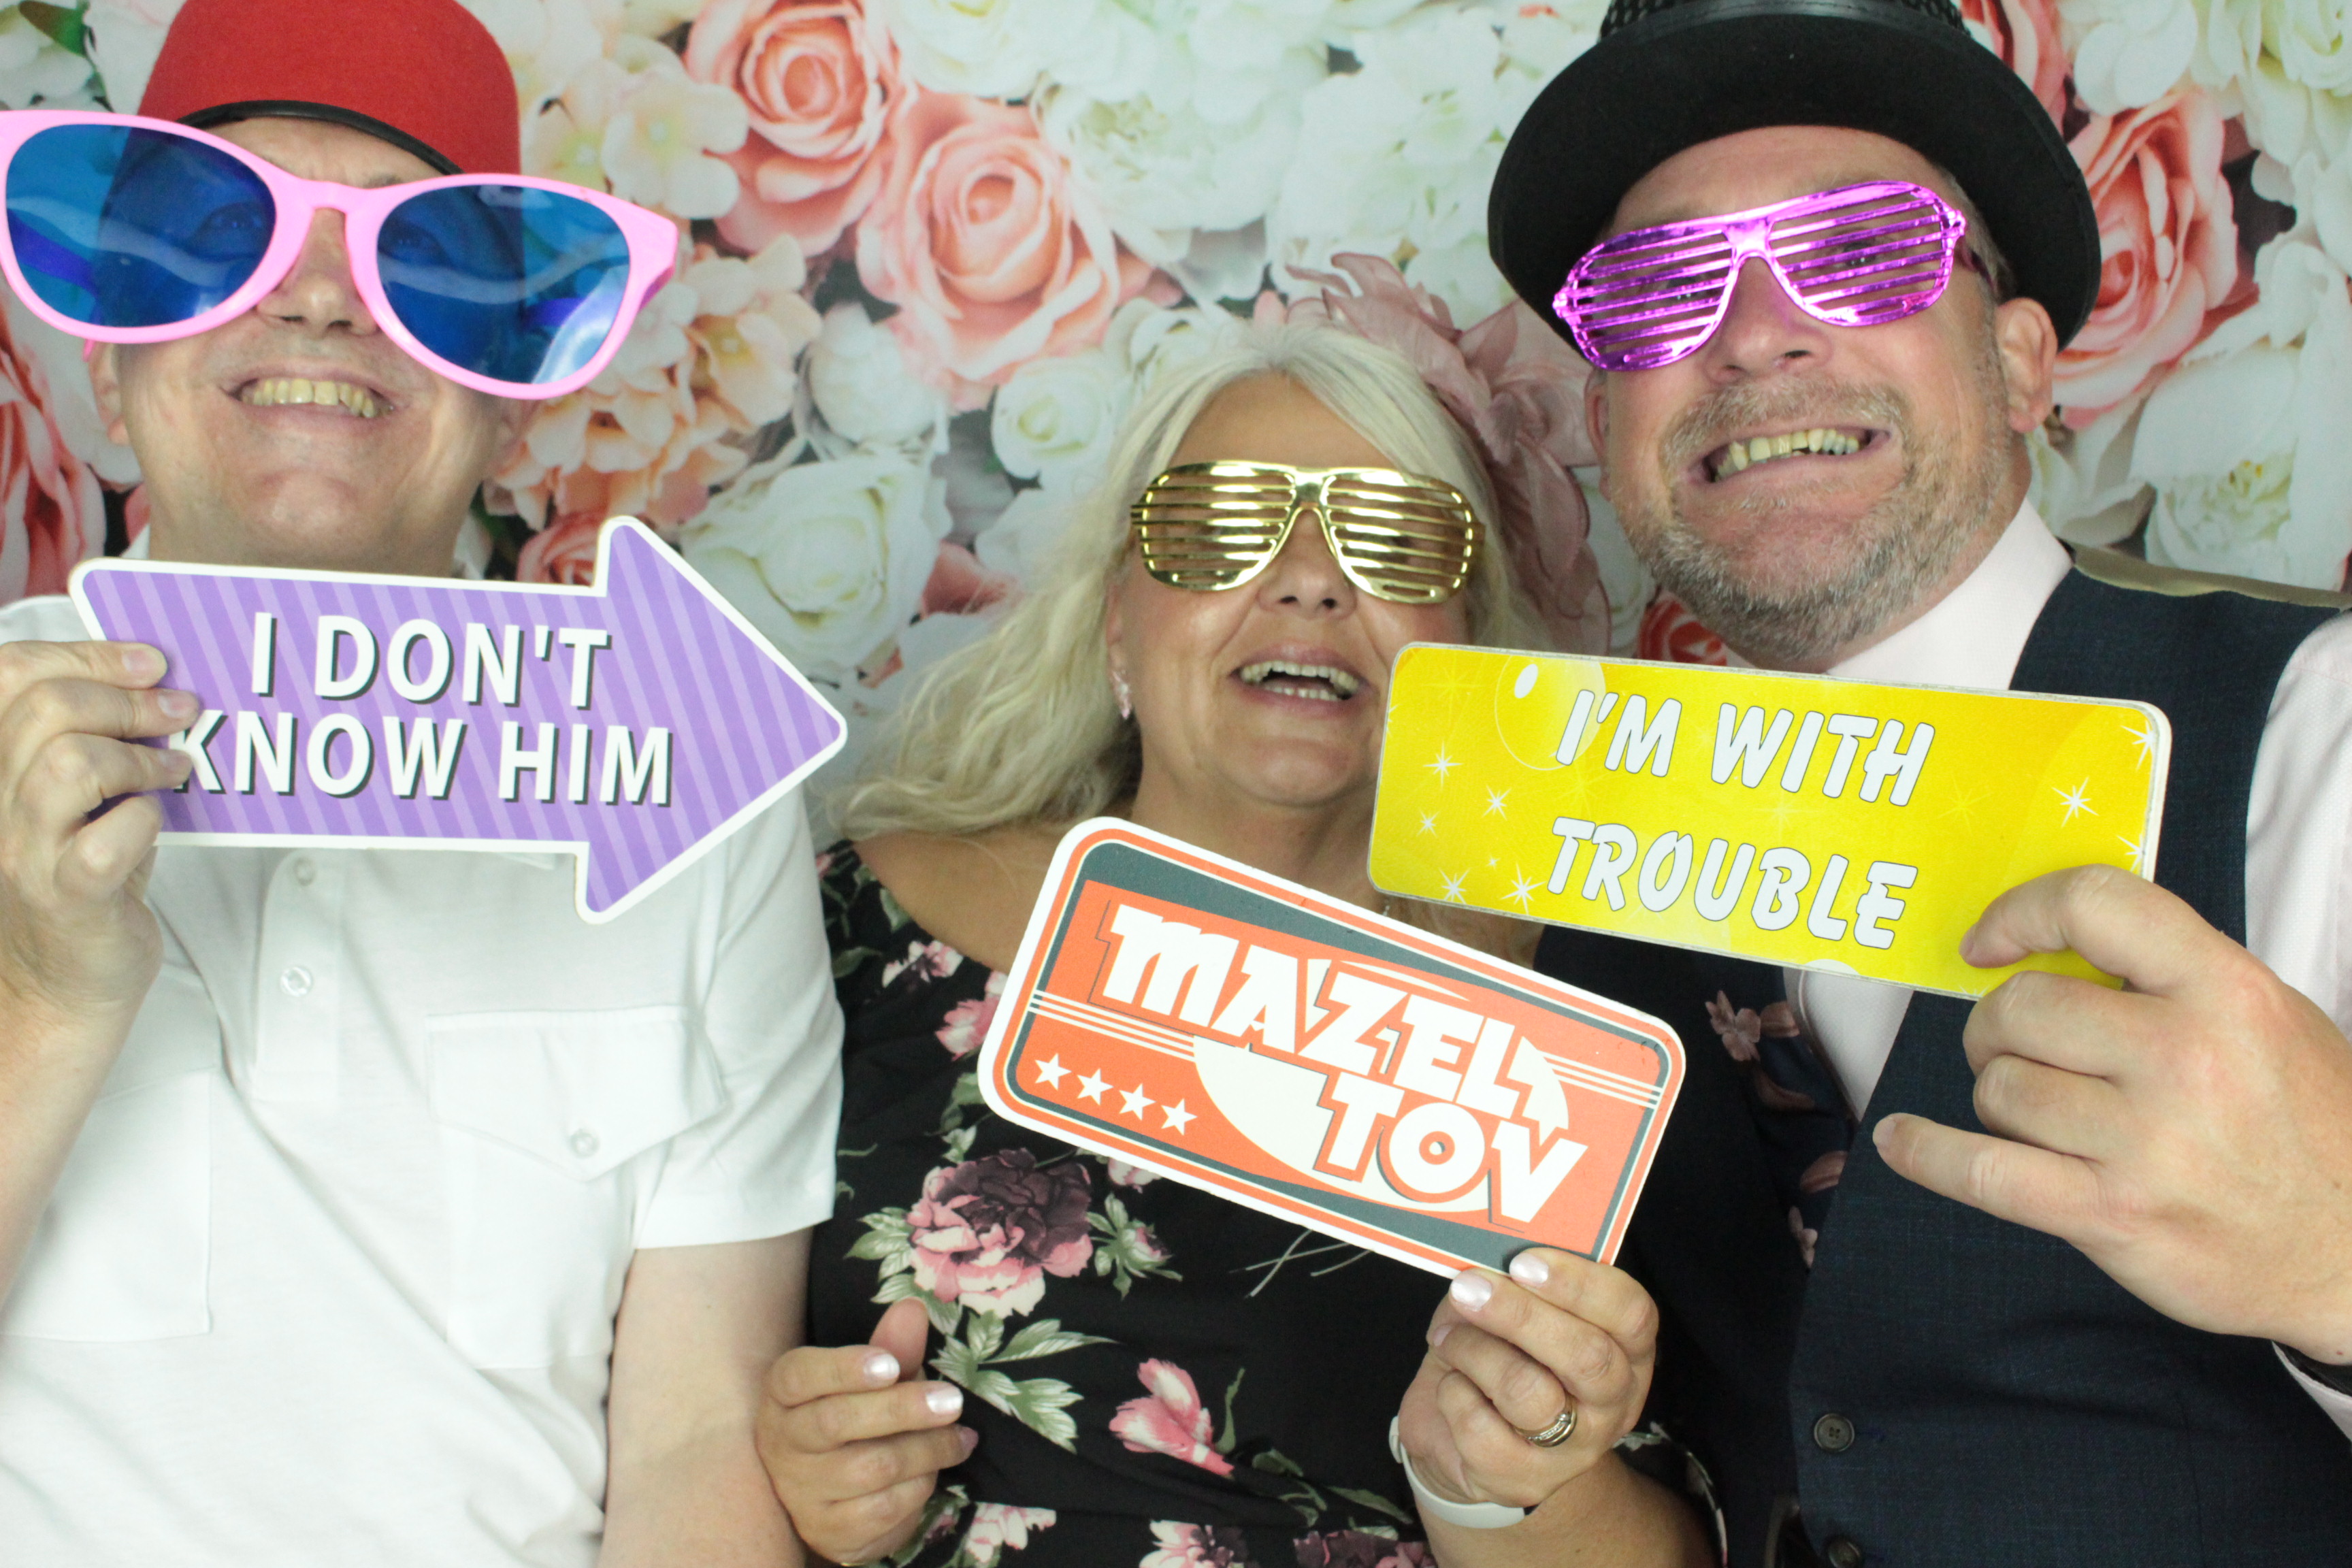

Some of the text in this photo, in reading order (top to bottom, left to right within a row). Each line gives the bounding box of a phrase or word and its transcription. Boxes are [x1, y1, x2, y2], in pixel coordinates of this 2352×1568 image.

[250, 611, 611, 710] I DON'T
[168, 708, 674, 806] KNOW HIM
[1556, 689, 1935, 807] I'M WITH
[1547, 817, 1918, 951] TROUBLE
[1101, 903, 1529, 1120] MAZEL
[1326, 1071, 1588, 1224] TOV
